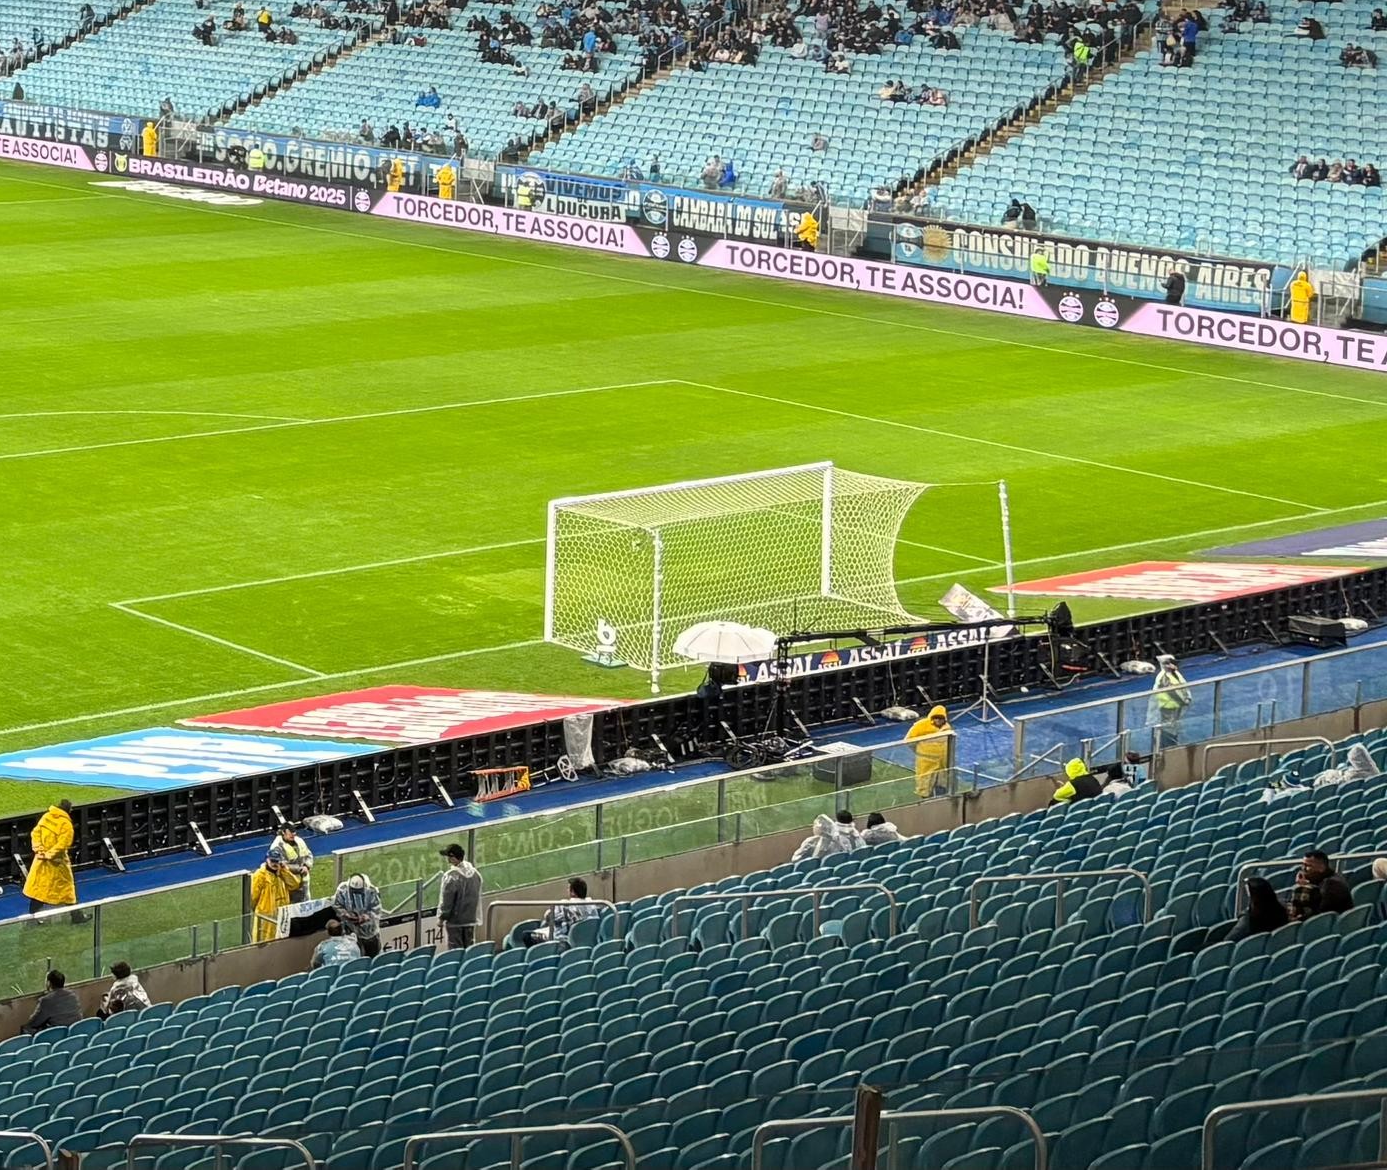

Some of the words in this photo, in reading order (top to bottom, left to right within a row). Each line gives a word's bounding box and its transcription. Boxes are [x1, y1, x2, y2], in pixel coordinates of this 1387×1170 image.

[13, 139, 77, 165] ASSOCIA!
[128, 156, 250, 191] BRASILEIRÃO
[252, 175, 309, 201] Betano
[309, 186, 346, 206] 2025
[393, 196, 500, 235] TORCEDOR,
[502, 212, 527, 232] TE
[529, 215, 625, 248] ASSOCIA!
[546, 198, 621, 221] LOUCURA
[736, 204, 752, 233] DO
[752, 206, 778, 240] SUL
[726, 245, 862, 290] TORCEDOR,
[866, 266, 895, 290] TE
[901, 271, 1025, 310] ASSOCIA!
[1197, 262, 1271, 306] AIRES
[1156, 309, 1330, 364] TORCEDOR,
[1337, 336, 1375, 363] TE
[392, 935, 409, 953] 113
[426, 927, 444, 945] 114
